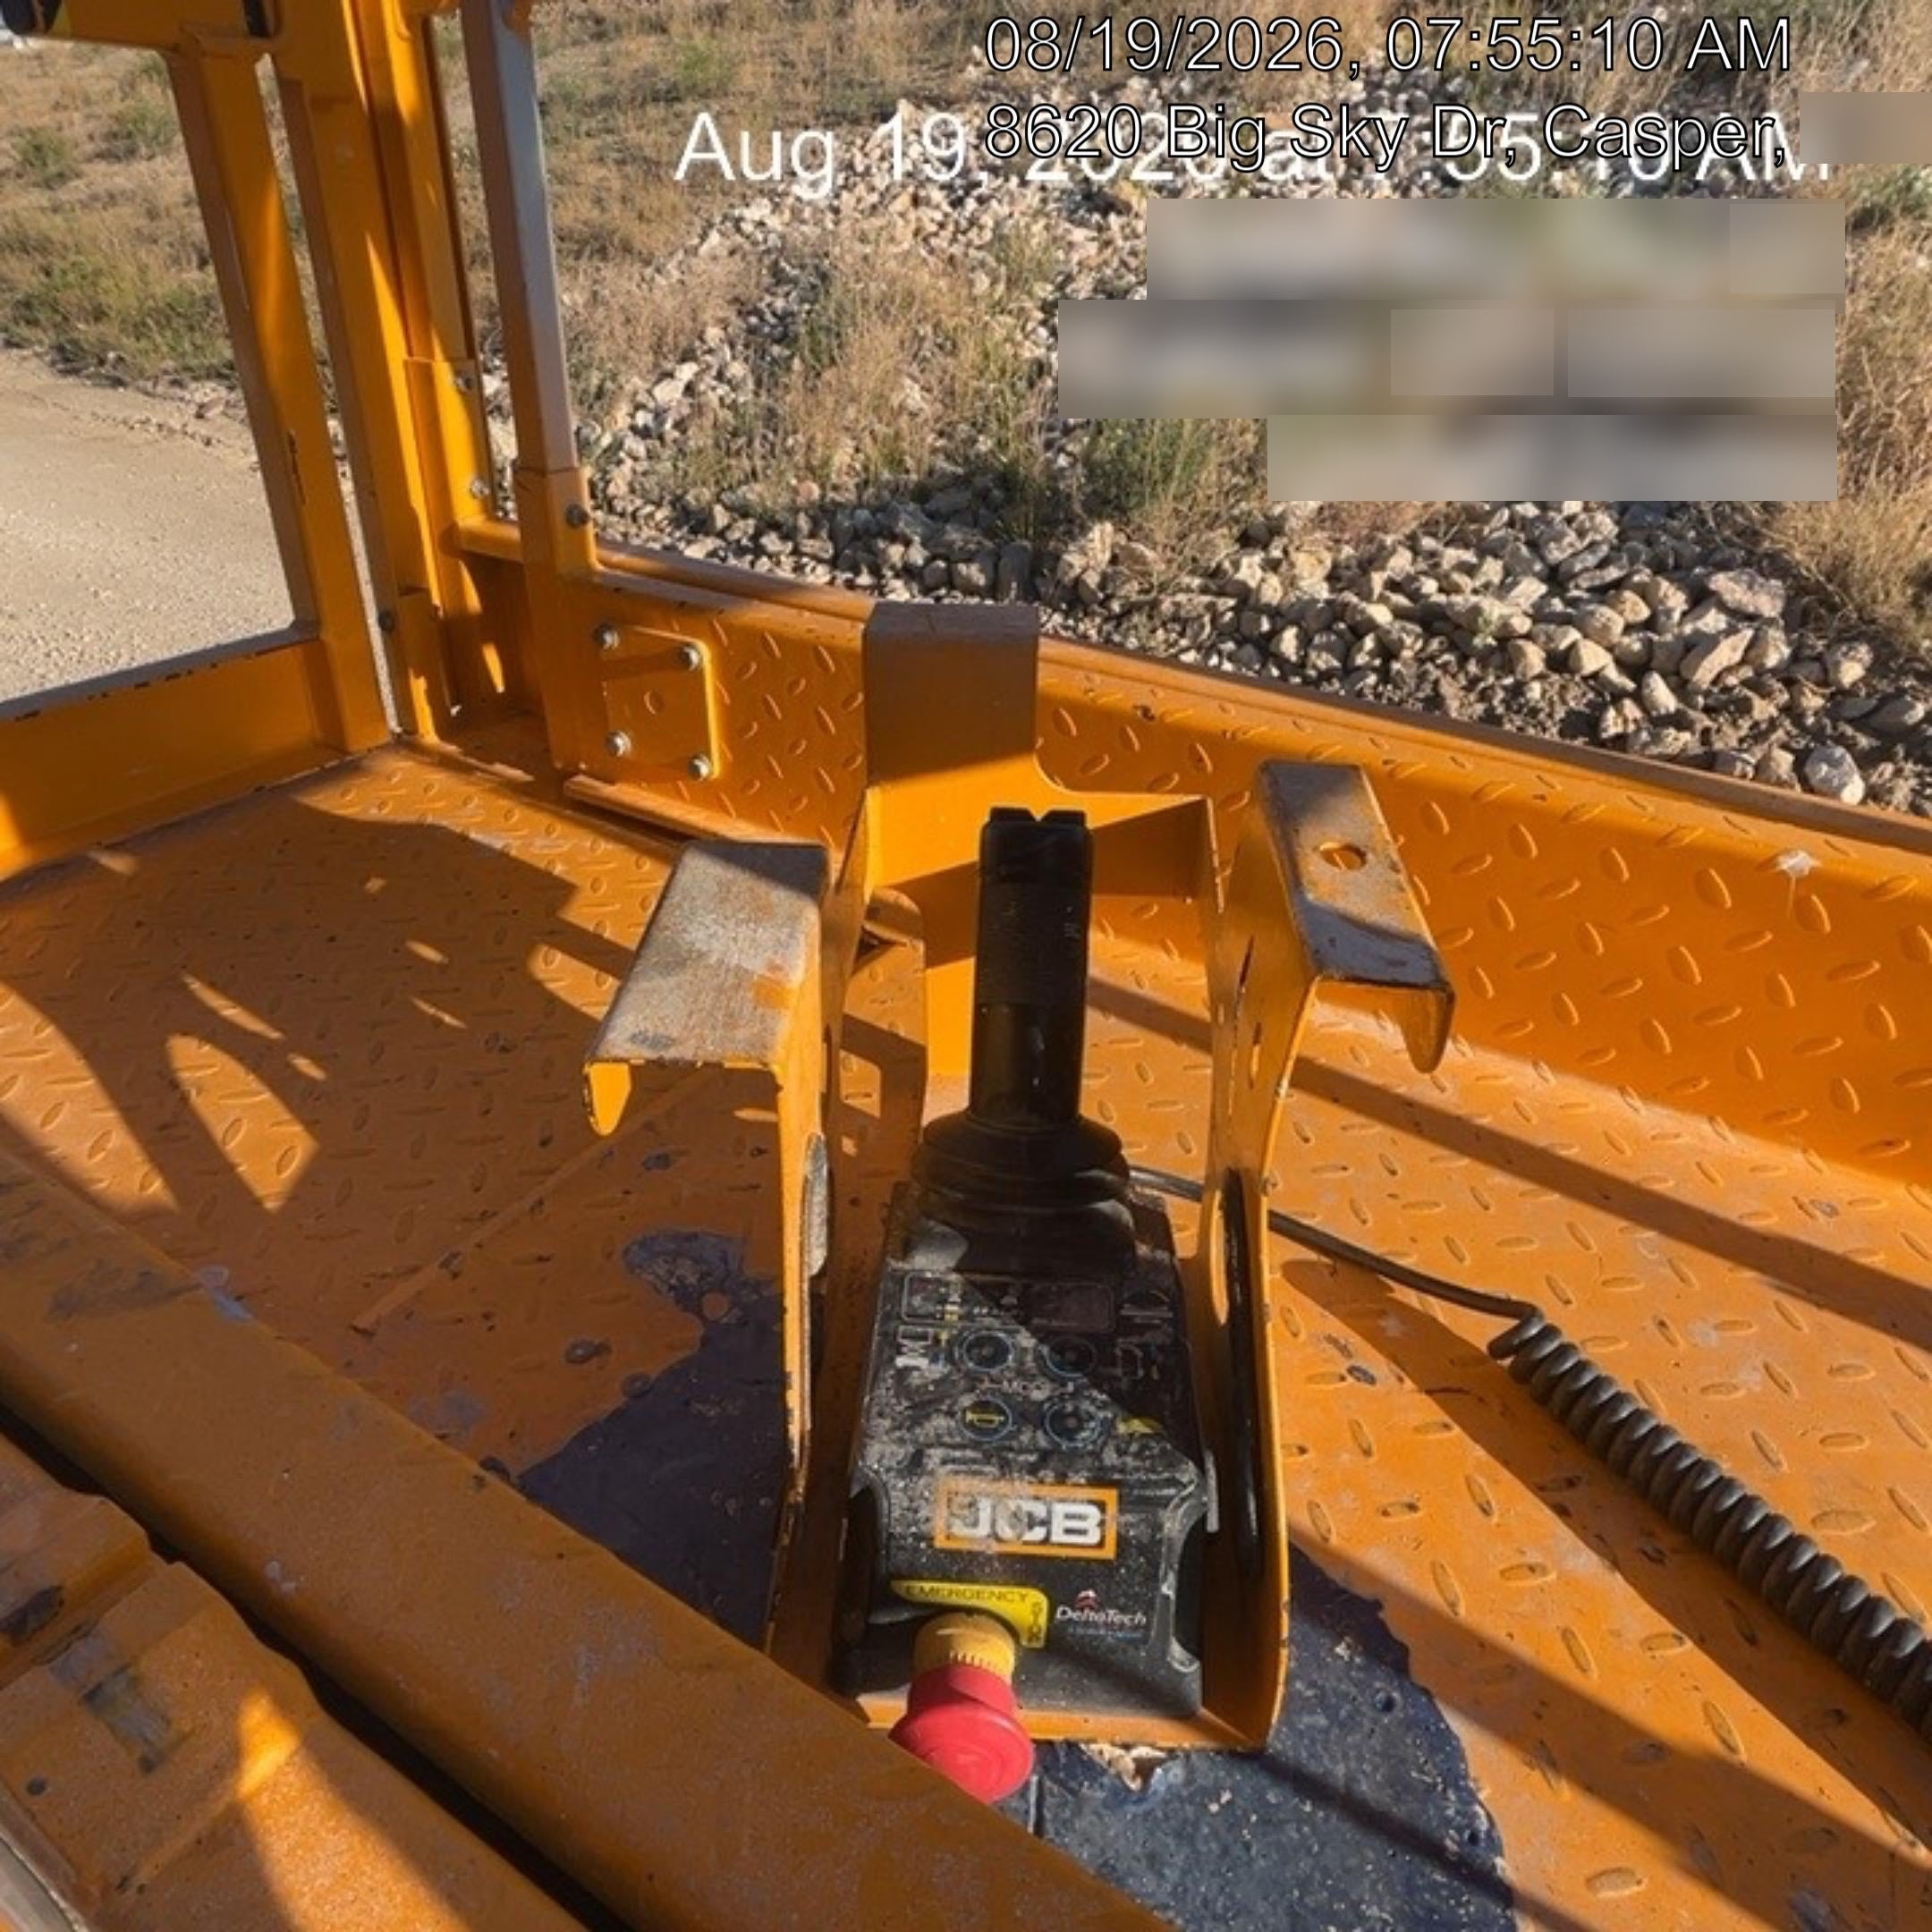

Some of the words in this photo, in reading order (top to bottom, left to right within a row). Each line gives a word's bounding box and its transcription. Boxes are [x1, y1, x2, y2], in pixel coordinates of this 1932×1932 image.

[949, 1490, 1104, 1546] JCB
[904, 1584, 1030, 1605] EMERGENCY
[1055, 1604, 1148, 1627] DeltaTech
